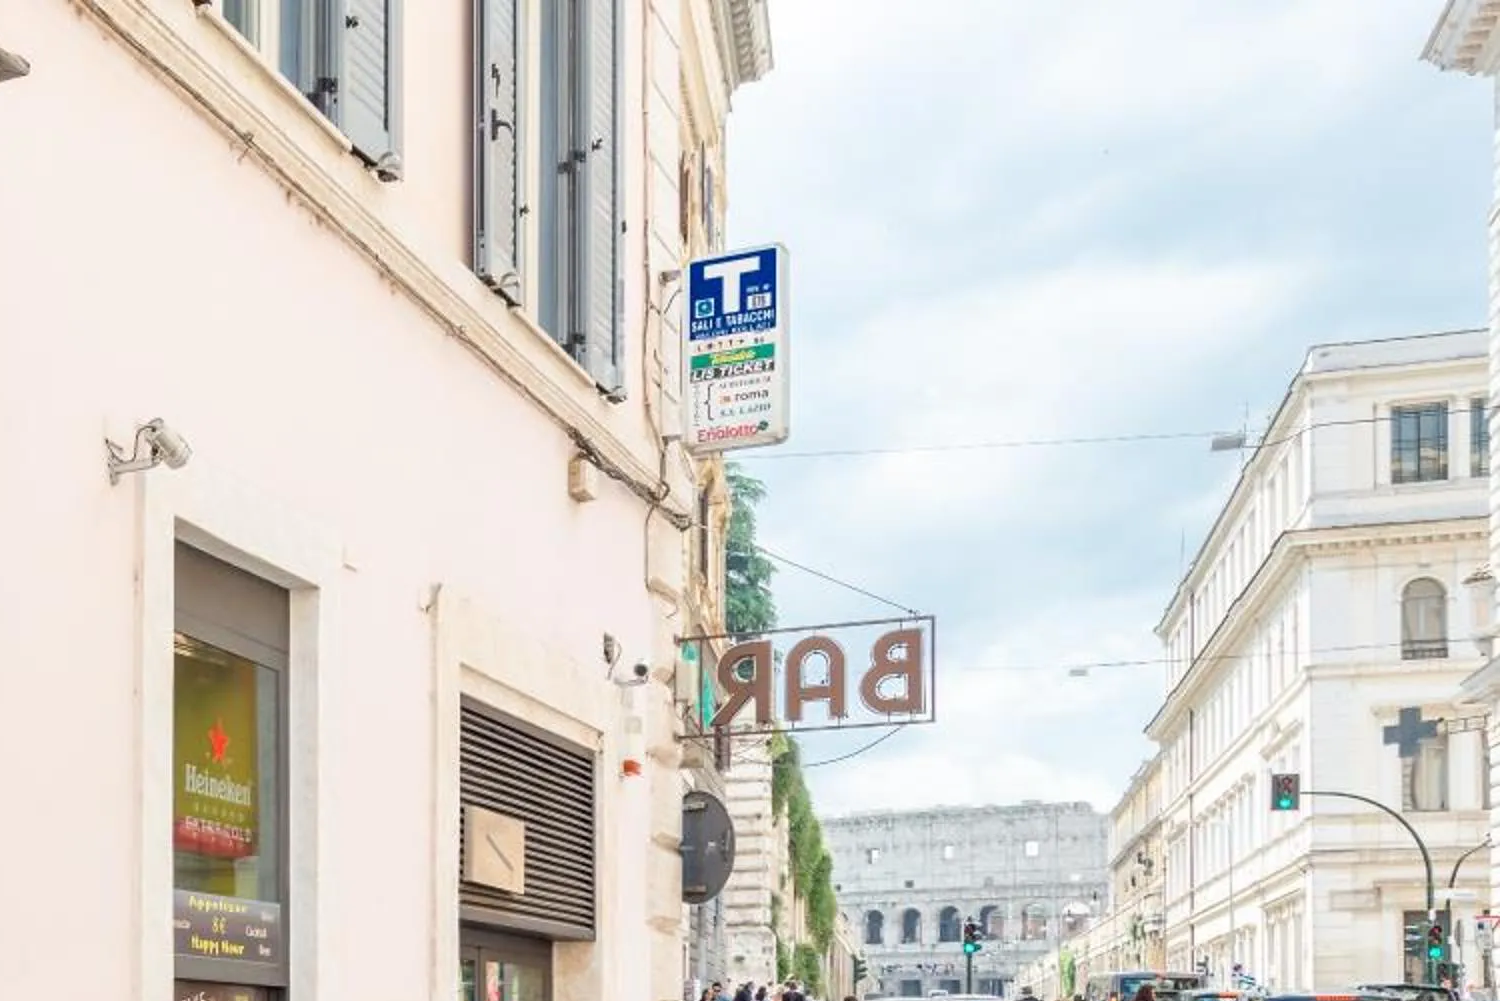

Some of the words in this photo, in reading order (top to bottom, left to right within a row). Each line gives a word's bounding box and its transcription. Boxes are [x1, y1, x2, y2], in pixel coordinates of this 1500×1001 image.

[703, 256, 760, 314] T
[691, 318, 714, 333] SALI
[725, 308, 775, 327] TABACCHI
[735, 388, 769, 402] roma
[698, 424, 757, 443] Enalotto
[184, 763, 252, 807] Heineken
